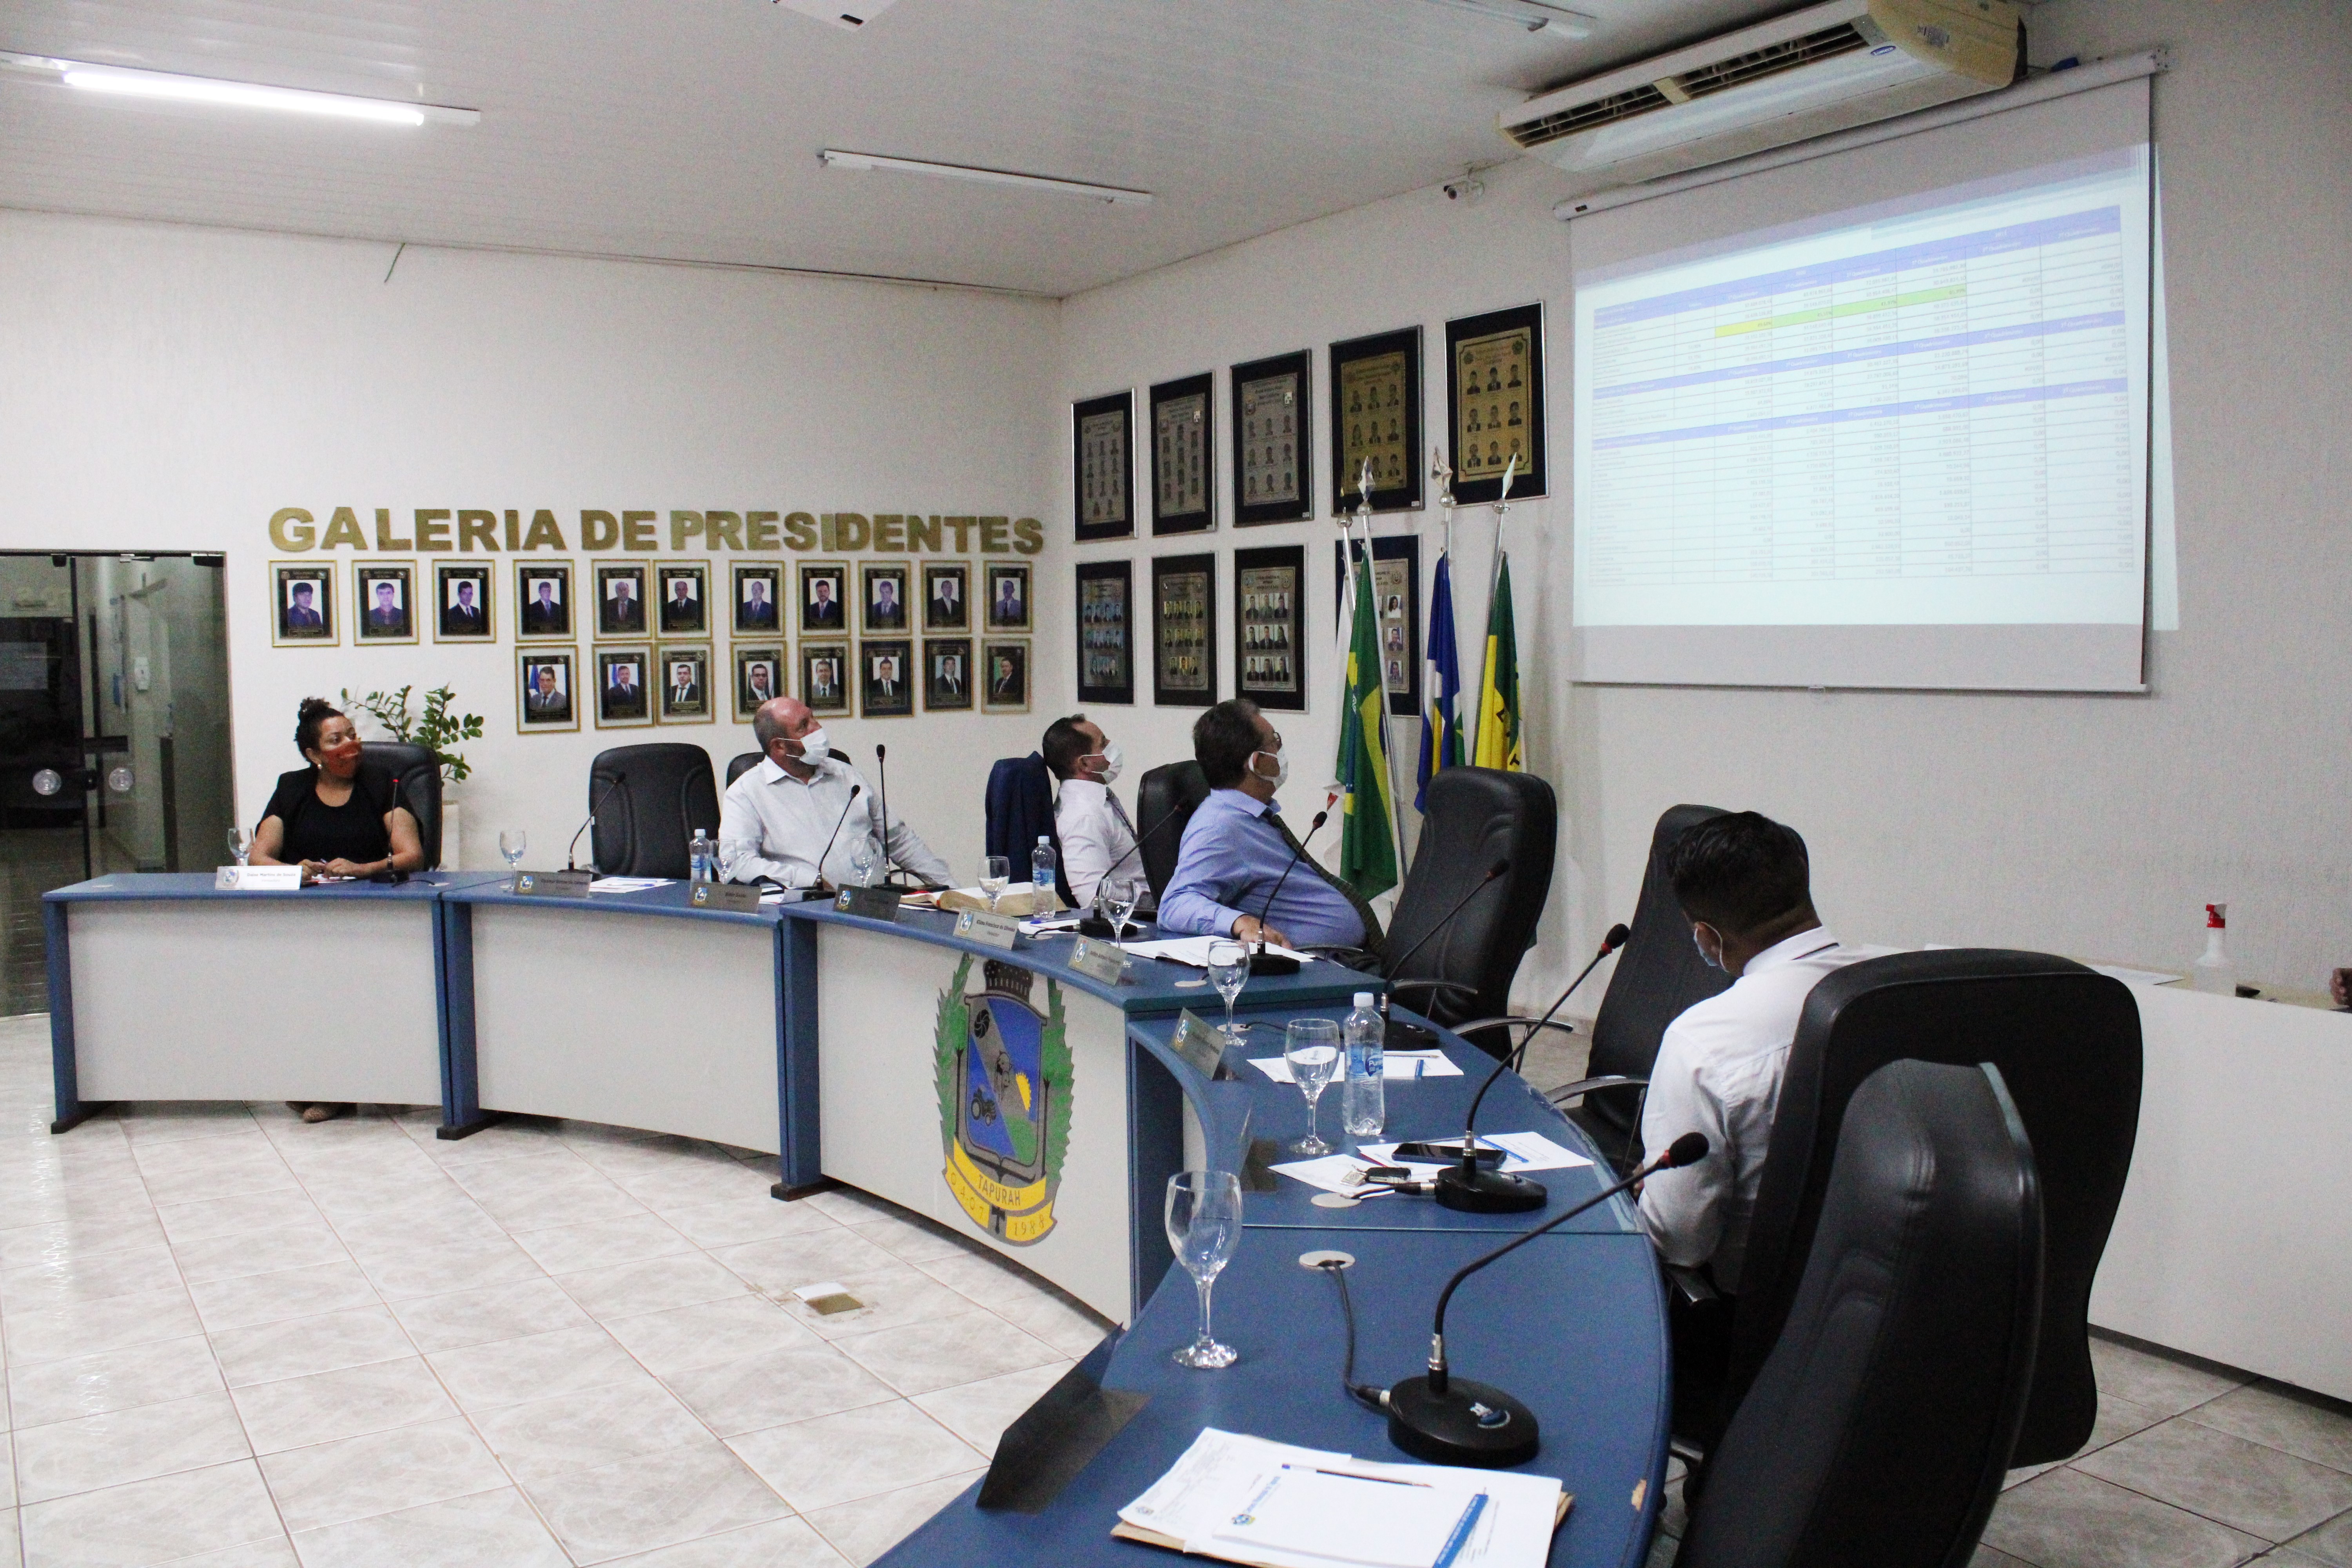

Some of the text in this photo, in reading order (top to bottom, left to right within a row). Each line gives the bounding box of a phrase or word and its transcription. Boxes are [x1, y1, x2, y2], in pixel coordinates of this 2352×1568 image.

[268, 506, 1044, 555] GALERIA DE PRESIDENTES
[978, 1174, 1021, 1206] TAPURAH
[1014, 1214, 1044, 1236] 1988
